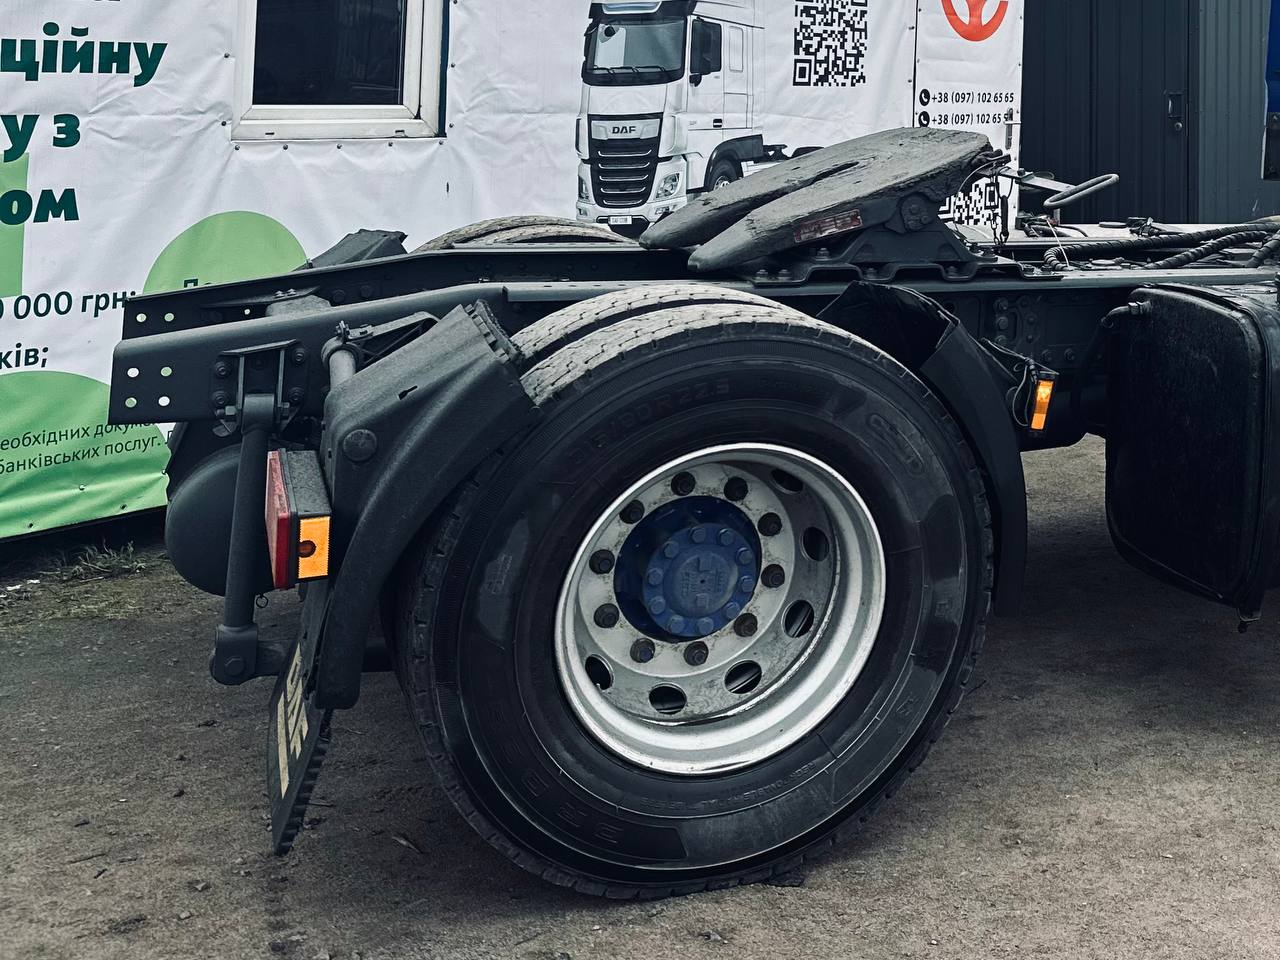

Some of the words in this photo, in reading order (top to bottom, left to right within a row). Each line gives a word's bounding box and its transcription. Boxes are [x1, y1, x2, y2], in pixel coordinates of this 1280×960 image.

[0, 21, 168, 87] ційну
[931, 92, 949, 103] +38
[951, 91, 975, 104] (097)
[977, 92, 991, 103] 102
[993, 92, 1003, 103] 65
[1004, 92, 1014, 103] 65
[931, 114, 949, 125] +38
[951, 113, 974, 125] (097)
[976, 113, 990, 124] 102
[992, 113, 1002, 123] 65
[612, 126, 636, 134] DAF
[105, 435, 161, 456] послуг.
